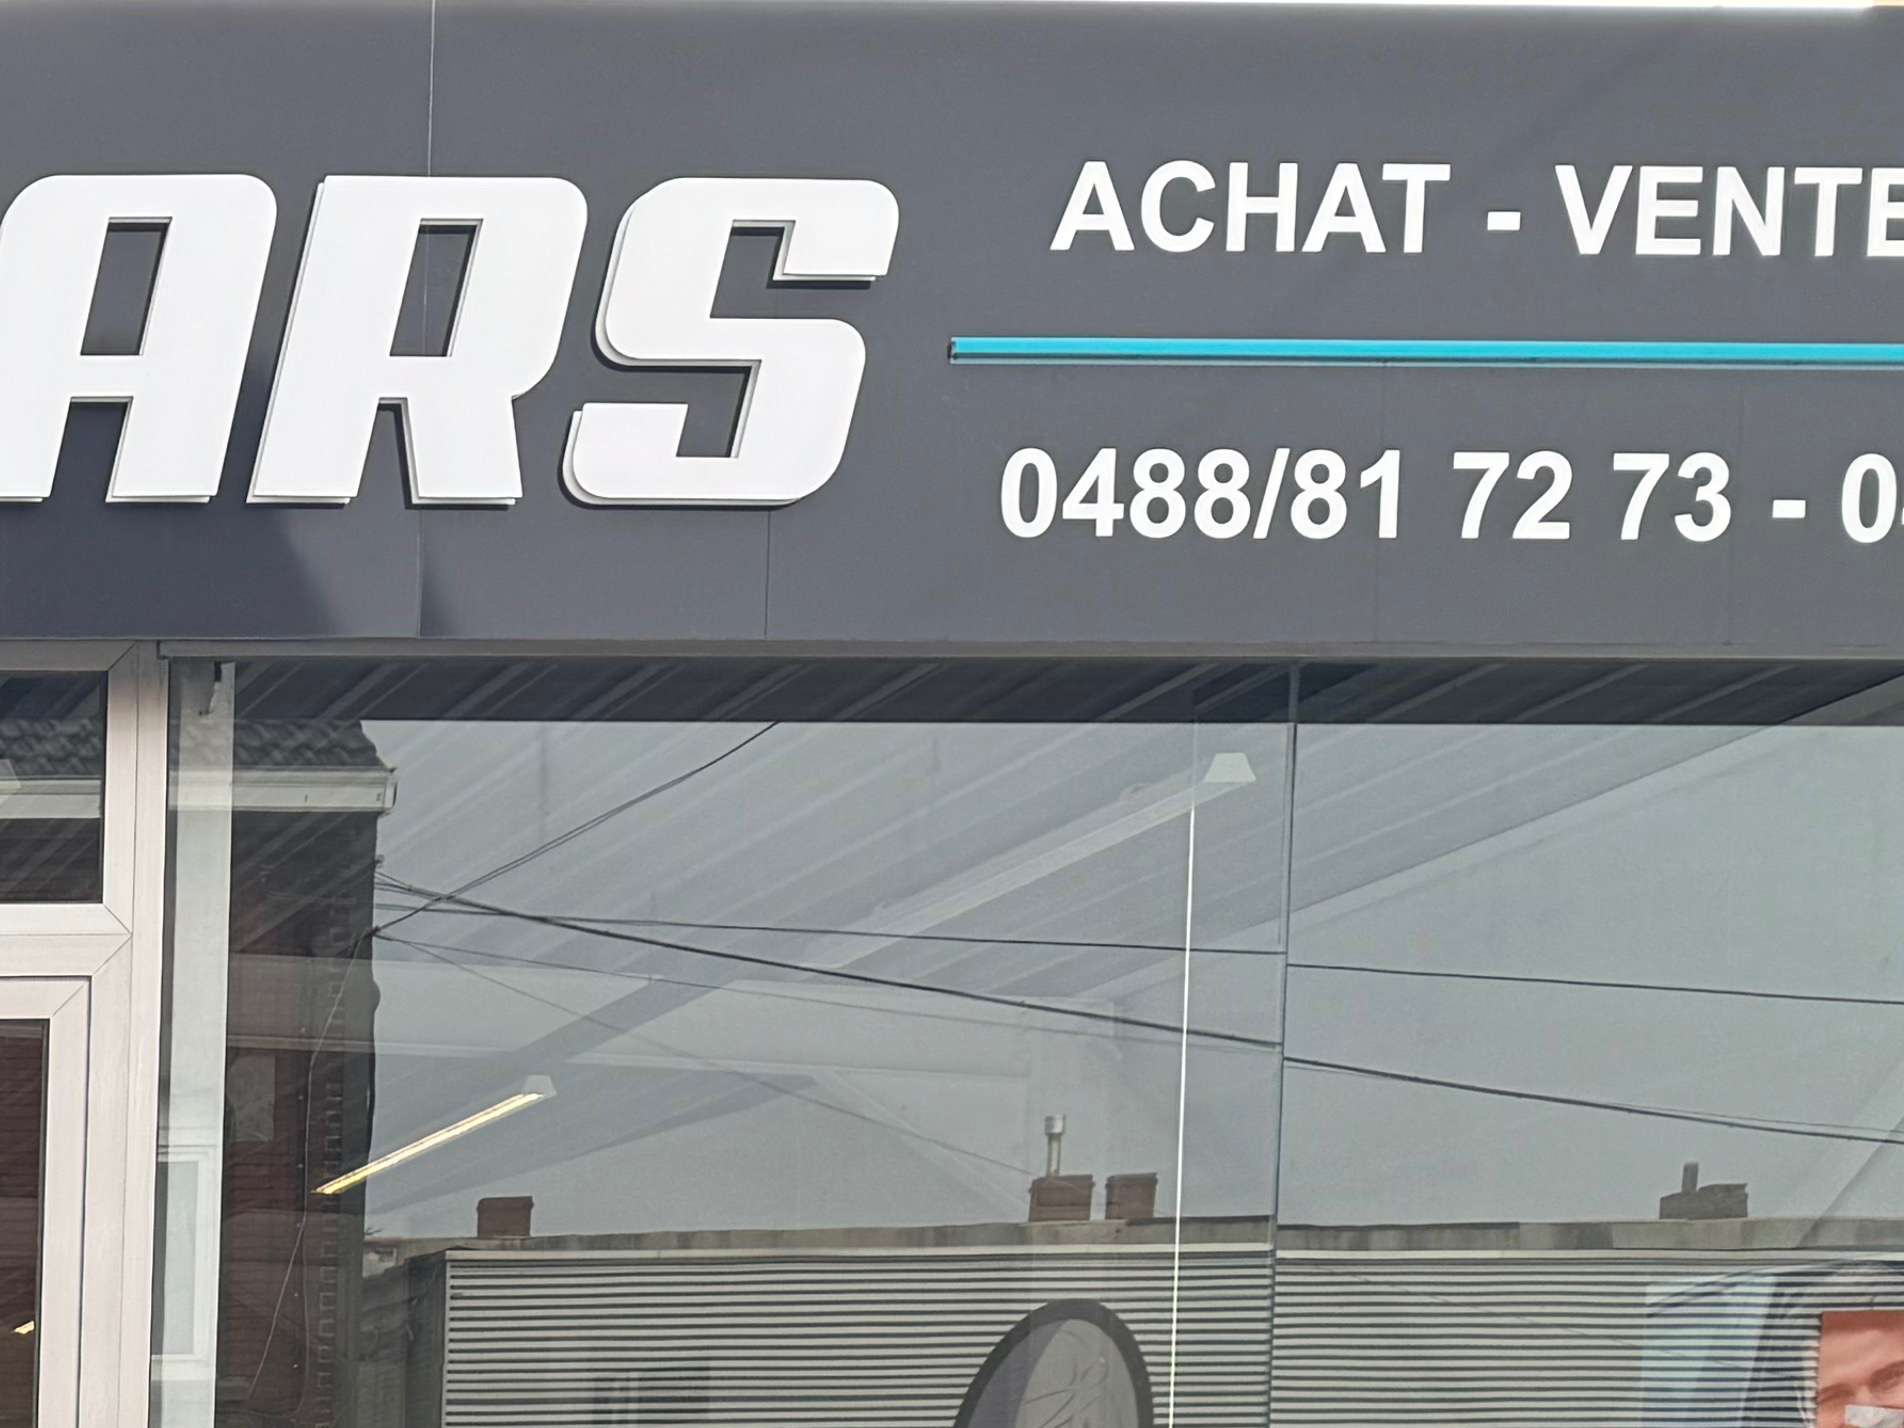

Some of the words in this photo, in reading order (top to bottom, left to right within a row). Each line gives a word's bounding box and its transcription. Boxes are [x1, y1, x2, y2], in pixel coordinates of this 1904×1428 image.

[1049, 160, 1452, 254] ACHAT
[1486, 211, 1522, 231] -
[1554, 165, 1904, 257] VENTE
[999, 447, 1402, 540] 0488/81
[1452, 450, 1572, 540] 72
[1612, 451, 1732, 542] 73
[1771, 498, 1807, 518] -
[1840, 453, 1904, 543] 0
